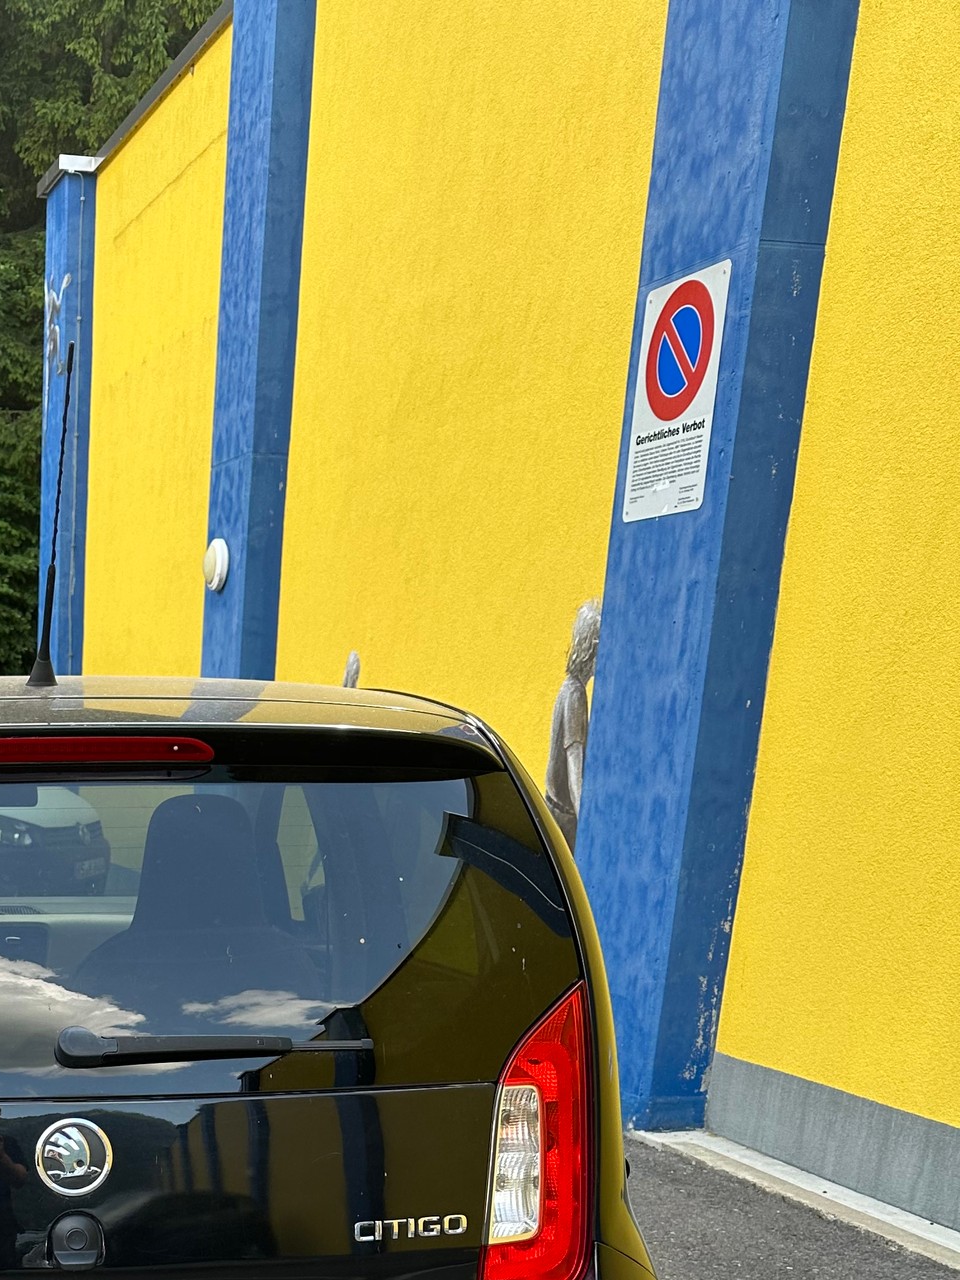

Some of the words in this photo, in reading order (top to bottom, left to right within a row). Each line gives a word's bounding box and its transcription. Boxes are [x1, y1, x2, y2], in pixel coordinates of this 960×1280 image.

[635, 426, 680, 446] Gerichtliches
[682, 418, 706, 434] Verbot
[354, 1214, 468, 1242] CITIGO
